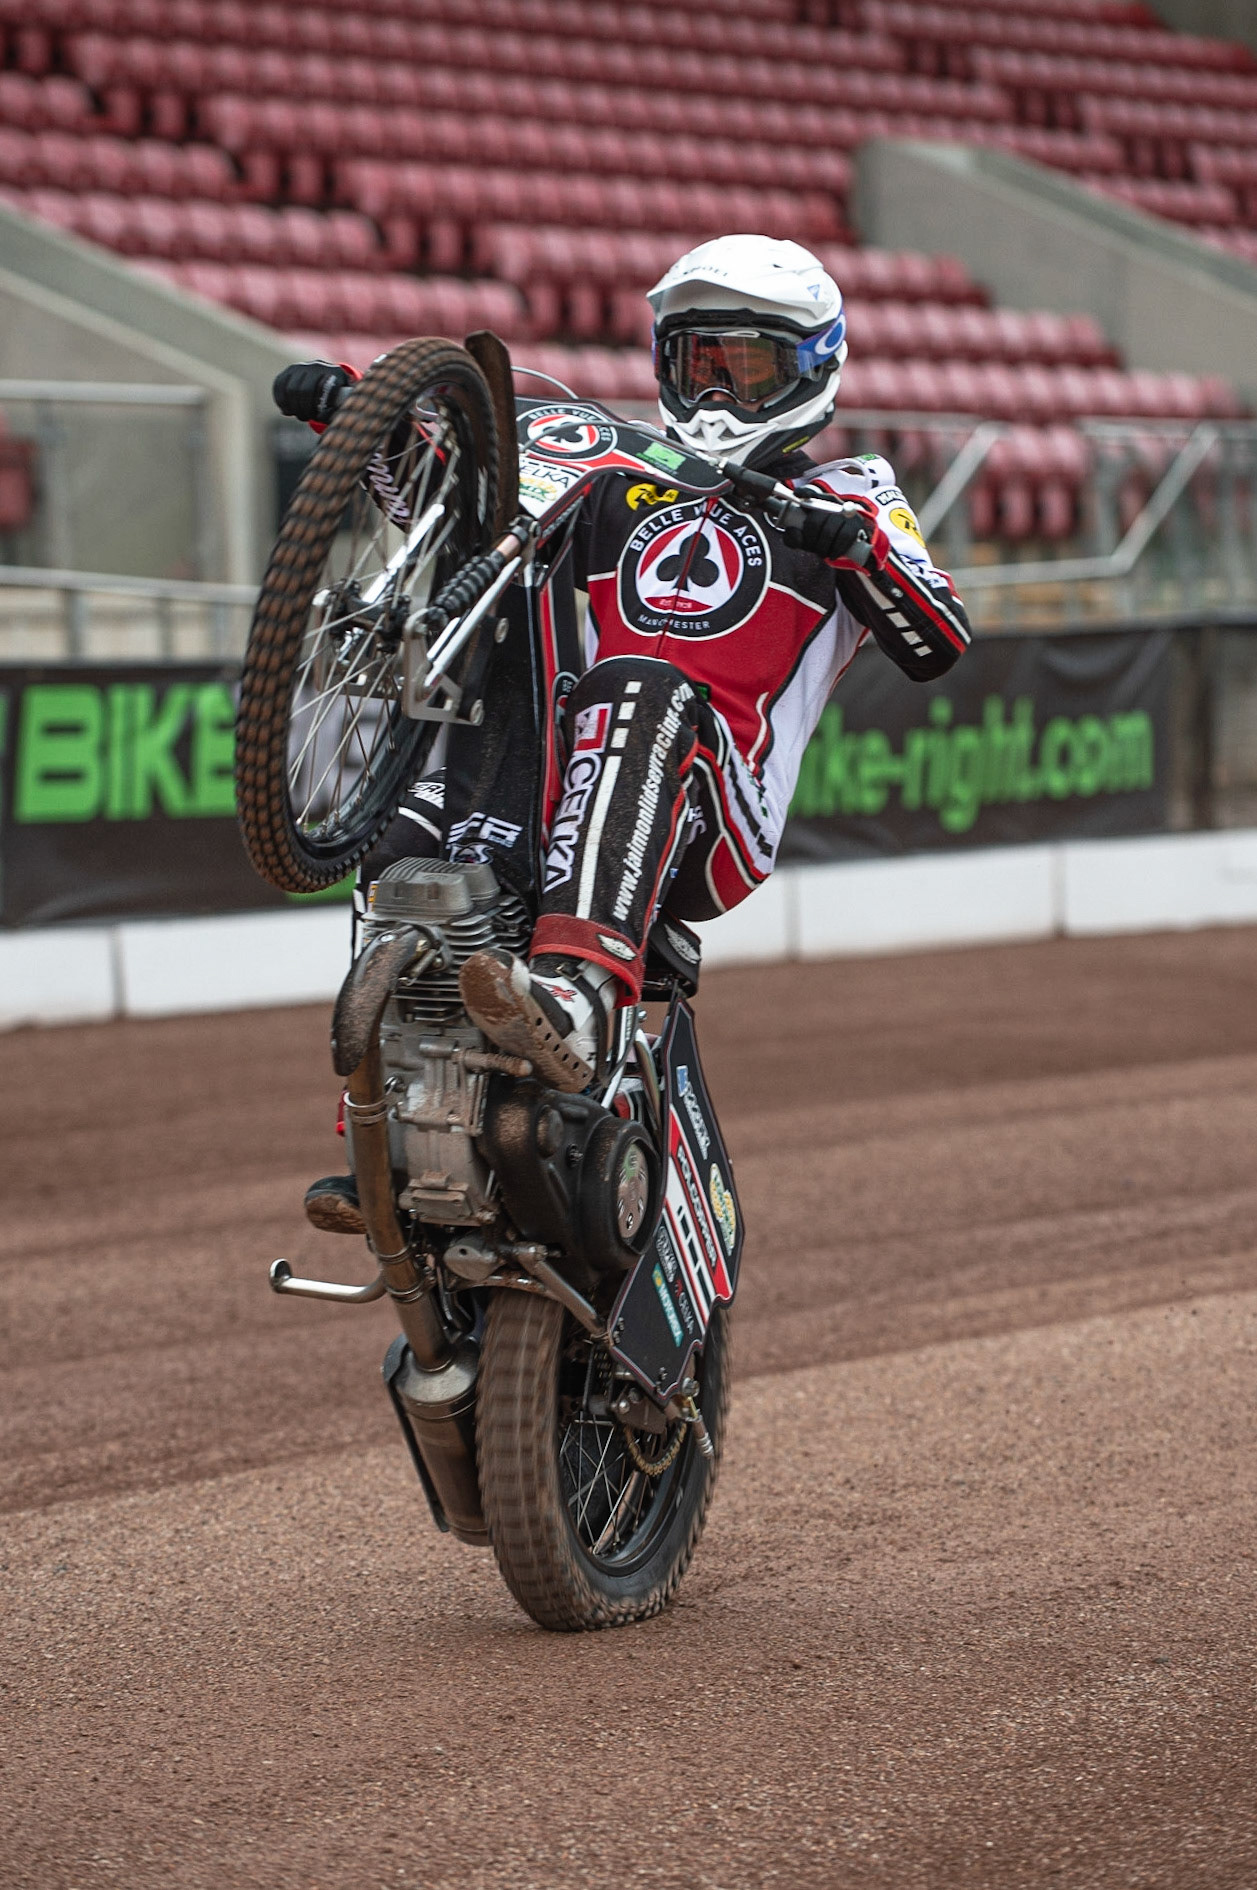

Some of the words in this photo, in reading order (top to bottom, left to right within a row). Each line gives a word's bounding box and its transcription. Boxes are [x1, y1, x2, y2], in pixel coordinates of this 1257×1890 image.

[519, 465, 570, 488] ELKA
[629, 508, 684, 551] BELLE
[733, 525, 763, 567] ACES
[788, 693, 1154, 835] ike-right.com
